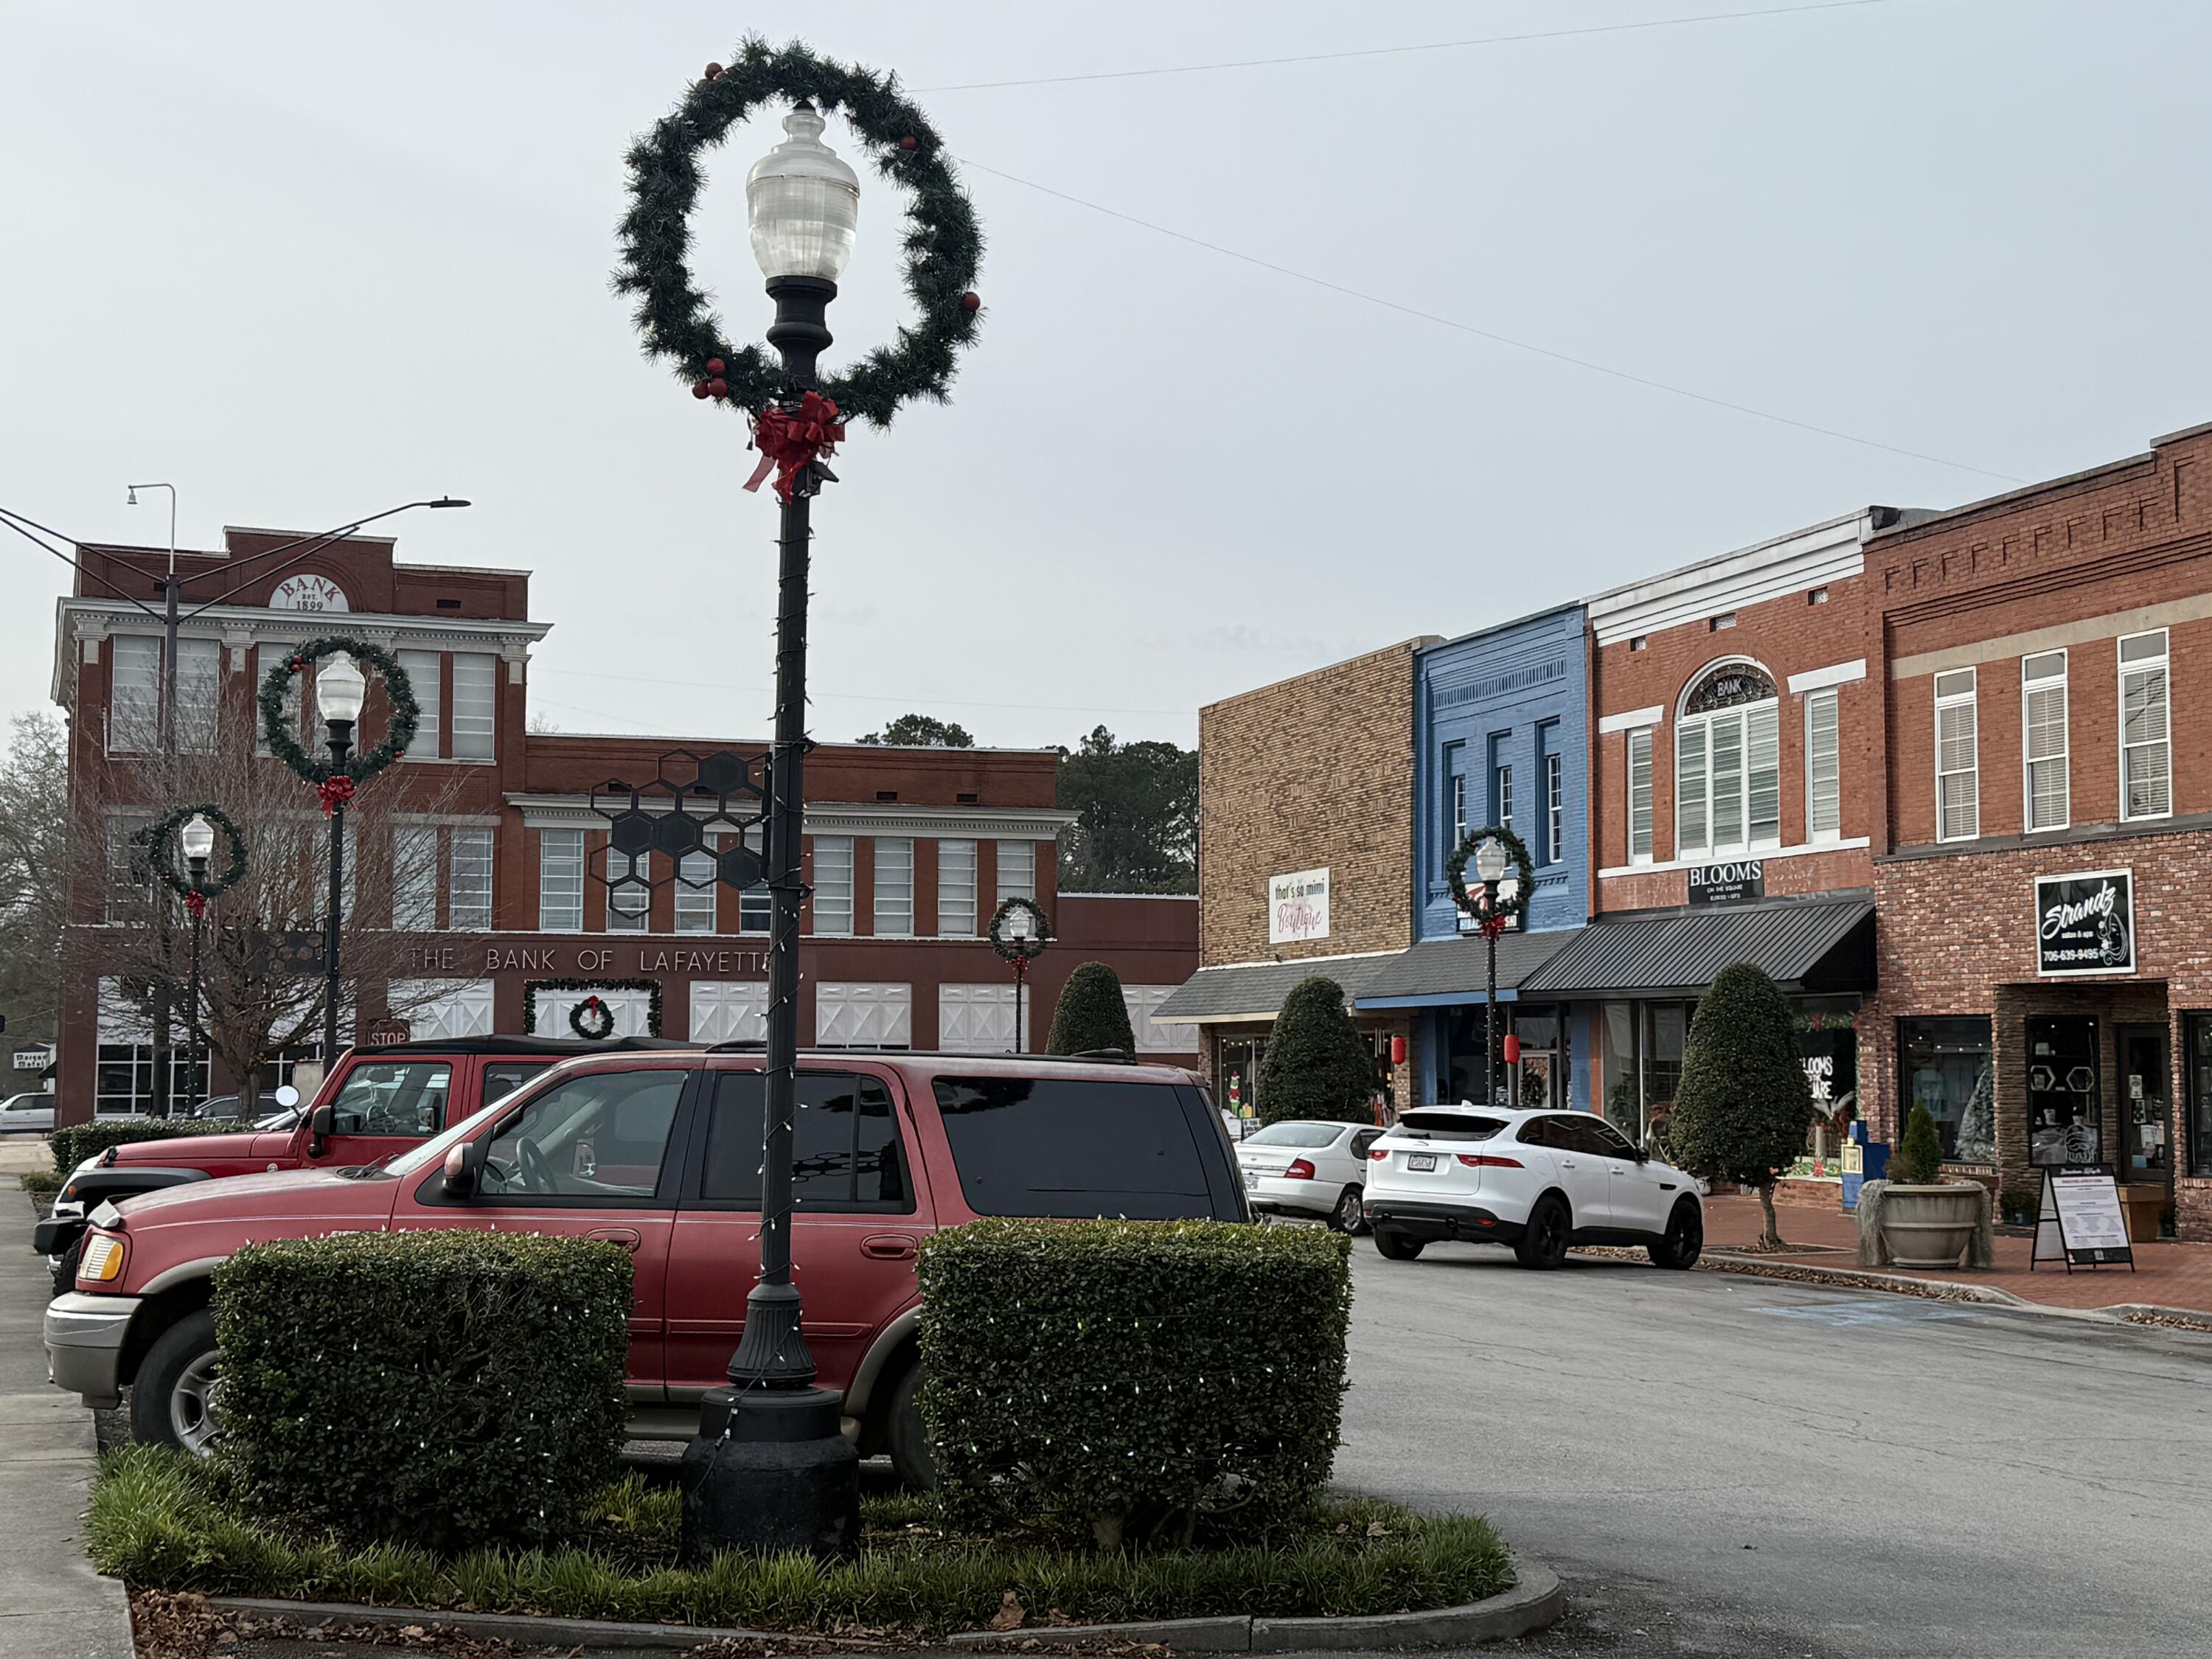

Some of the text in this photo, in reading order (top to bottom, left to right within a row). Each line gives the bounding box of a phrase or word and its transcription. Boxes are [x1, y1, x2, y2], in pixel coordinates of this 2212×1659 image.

[280, 577, 341, 602] BANK
[296, 601, 323, 611] 1899
[1718, 678, 1742, 697] BANK
[1690, 860, 1761, 886] BLOOMS
[1277, 903, 1322, 938] Boutique
[2041, 880, 2116, 939] Strandz
[410, 948, 454, 969] THE
[487, 949, 555, 970] BANK
[578, 950, 613, 970] OF
[371, 1032, 406, 1046] STOP
